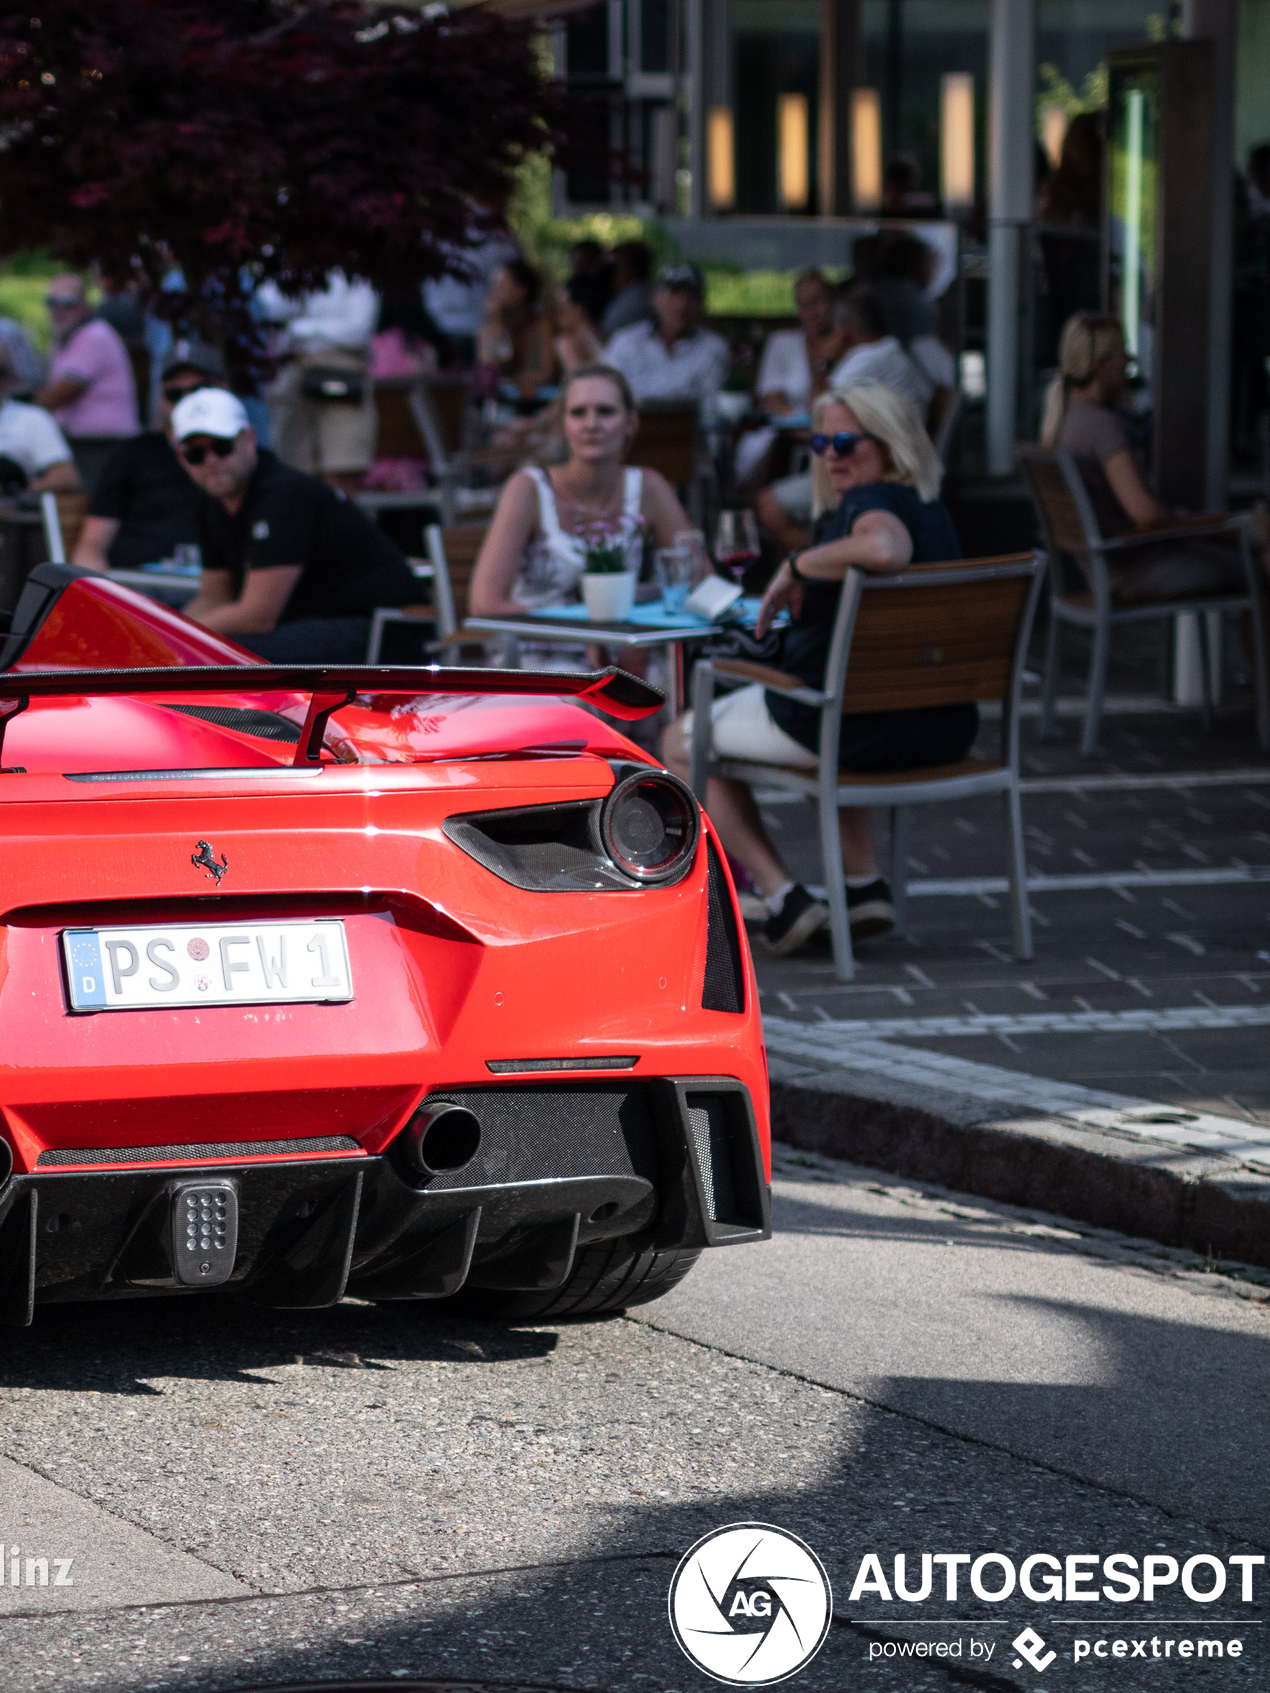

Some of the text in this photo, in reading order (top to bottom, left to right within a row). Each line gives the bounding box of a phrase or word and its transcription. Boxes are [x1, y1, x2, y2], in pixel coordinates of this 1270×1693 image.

[105, 932, 341, 995] PS FW 1
[82, 976, 96, 994] D
